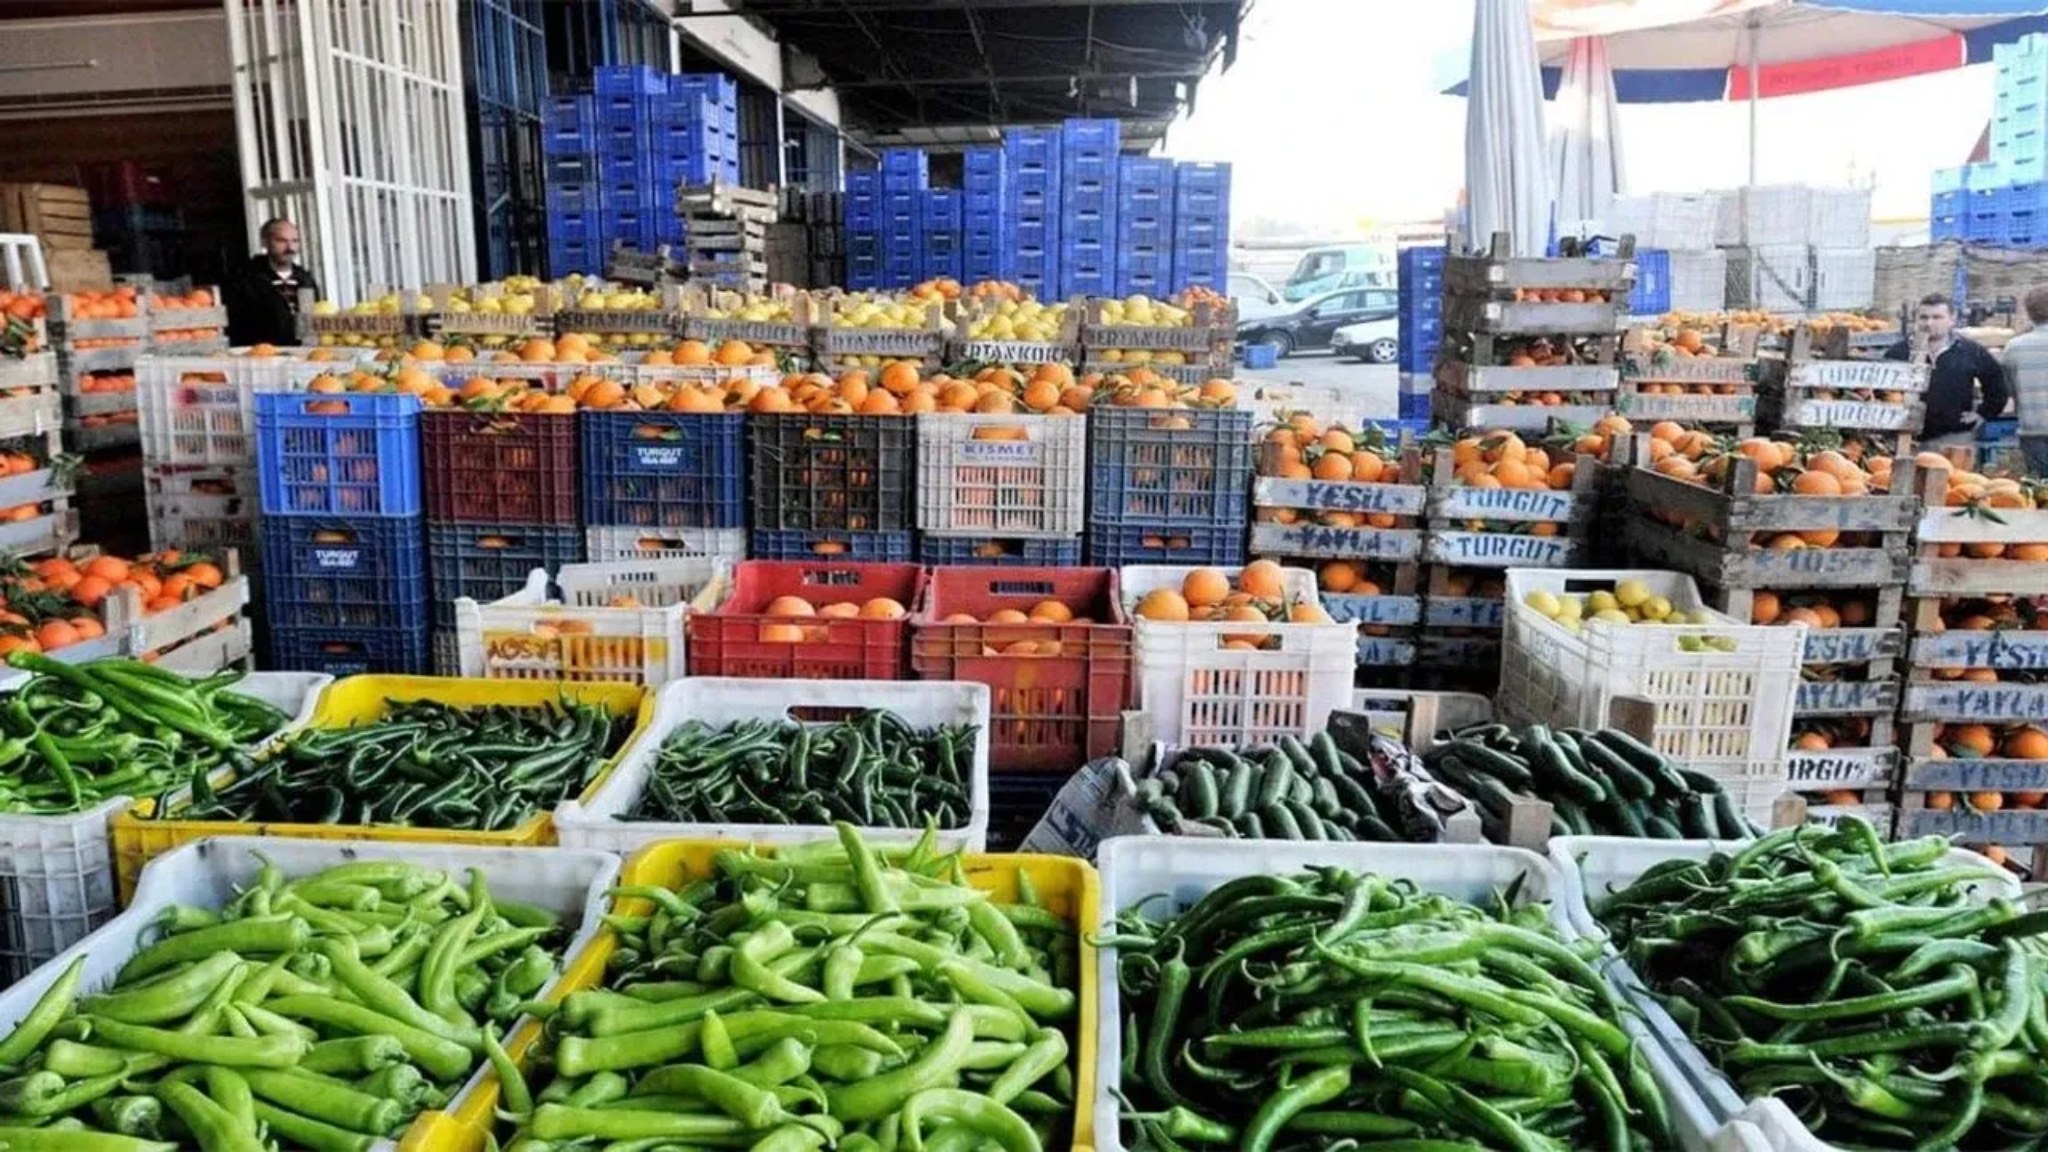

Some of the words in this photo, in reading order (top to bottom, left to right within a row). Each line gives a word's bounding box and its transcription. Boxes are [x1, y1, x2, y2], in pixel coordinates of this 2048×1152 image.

[963, 444, 1035, 454] KISMET
[1463, 488, 1566, 518] TURGUT
[1457, 535, 1562, 561] TURGUT
[1803, 633, 1868, 661] ESiL
[1797, 685, 1862, 709] AYLA
[1958, 689, 2045, 717] YAYLA
